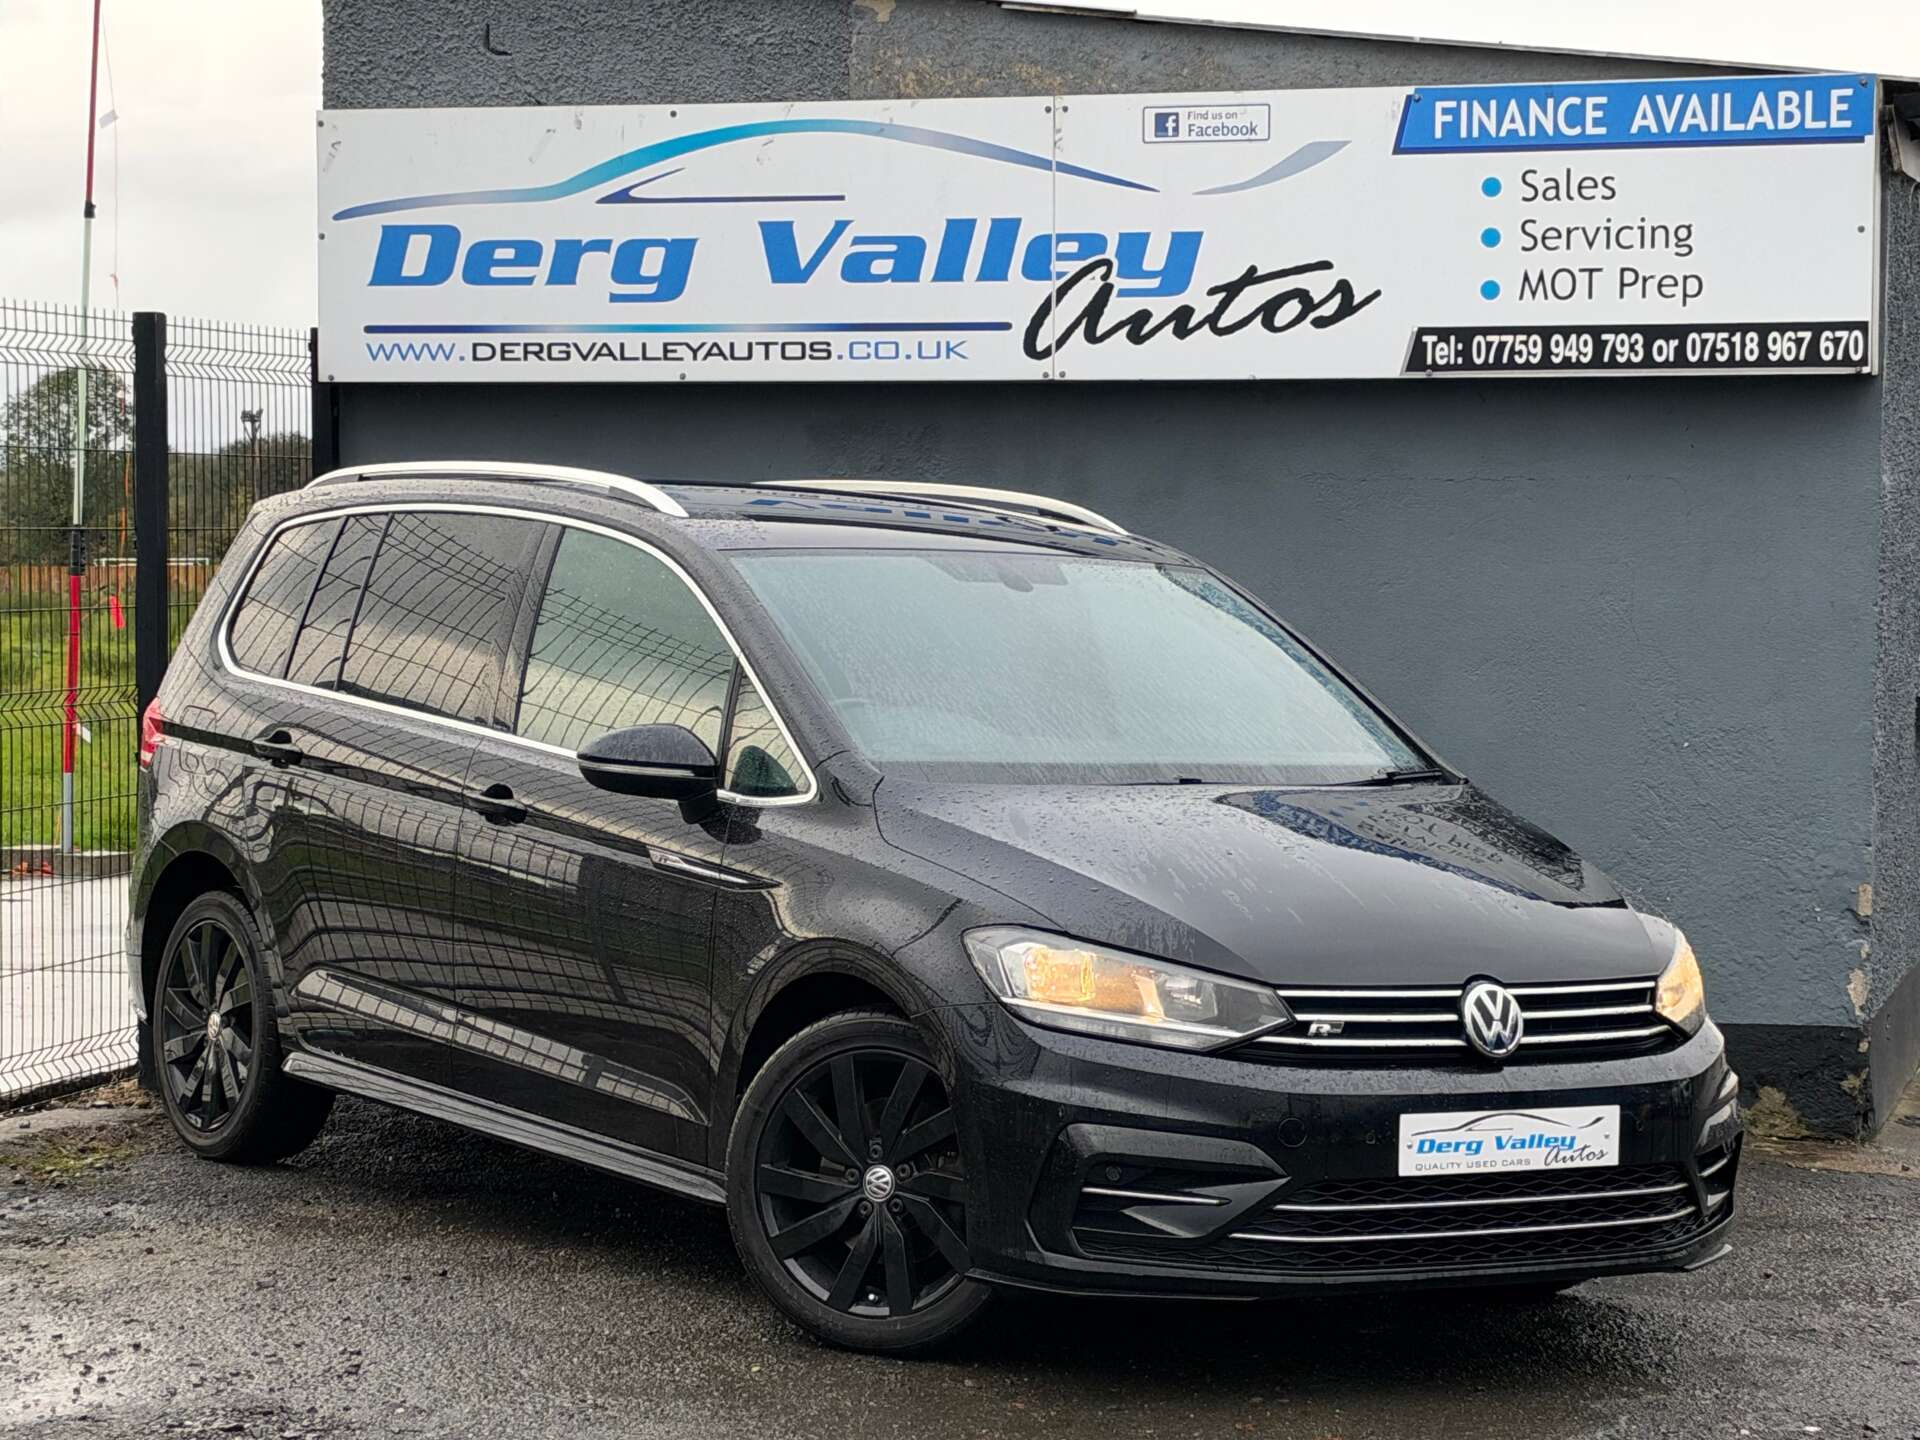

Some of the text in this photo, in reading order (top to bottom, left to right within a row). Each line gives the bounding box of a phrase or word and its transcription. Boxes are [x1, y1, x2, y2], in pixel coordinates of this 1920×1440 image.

[1187, 110, 1209, 121] Find
[1225, 112, 1238, 120] on
[1187, 120, 1259, 137] Facebook
[1434, 88, 1855, 140] FINANCE AVAILABLE
[1520, 169, 1617, 202] Sales
[1520, 217, 1694, 257] Servicing
[367, 217, 1204, 303] Derg Valley
[1518, 268, 1704, 307] MOT Prep
[1422, 330, 1864, 366] Tel: 07759 949 793 or 07518 967 670
[1415, 1133, 1576, 1156] Derg Valley
[1415, 1158, 1531, 1171] QUALITY USED CARS
